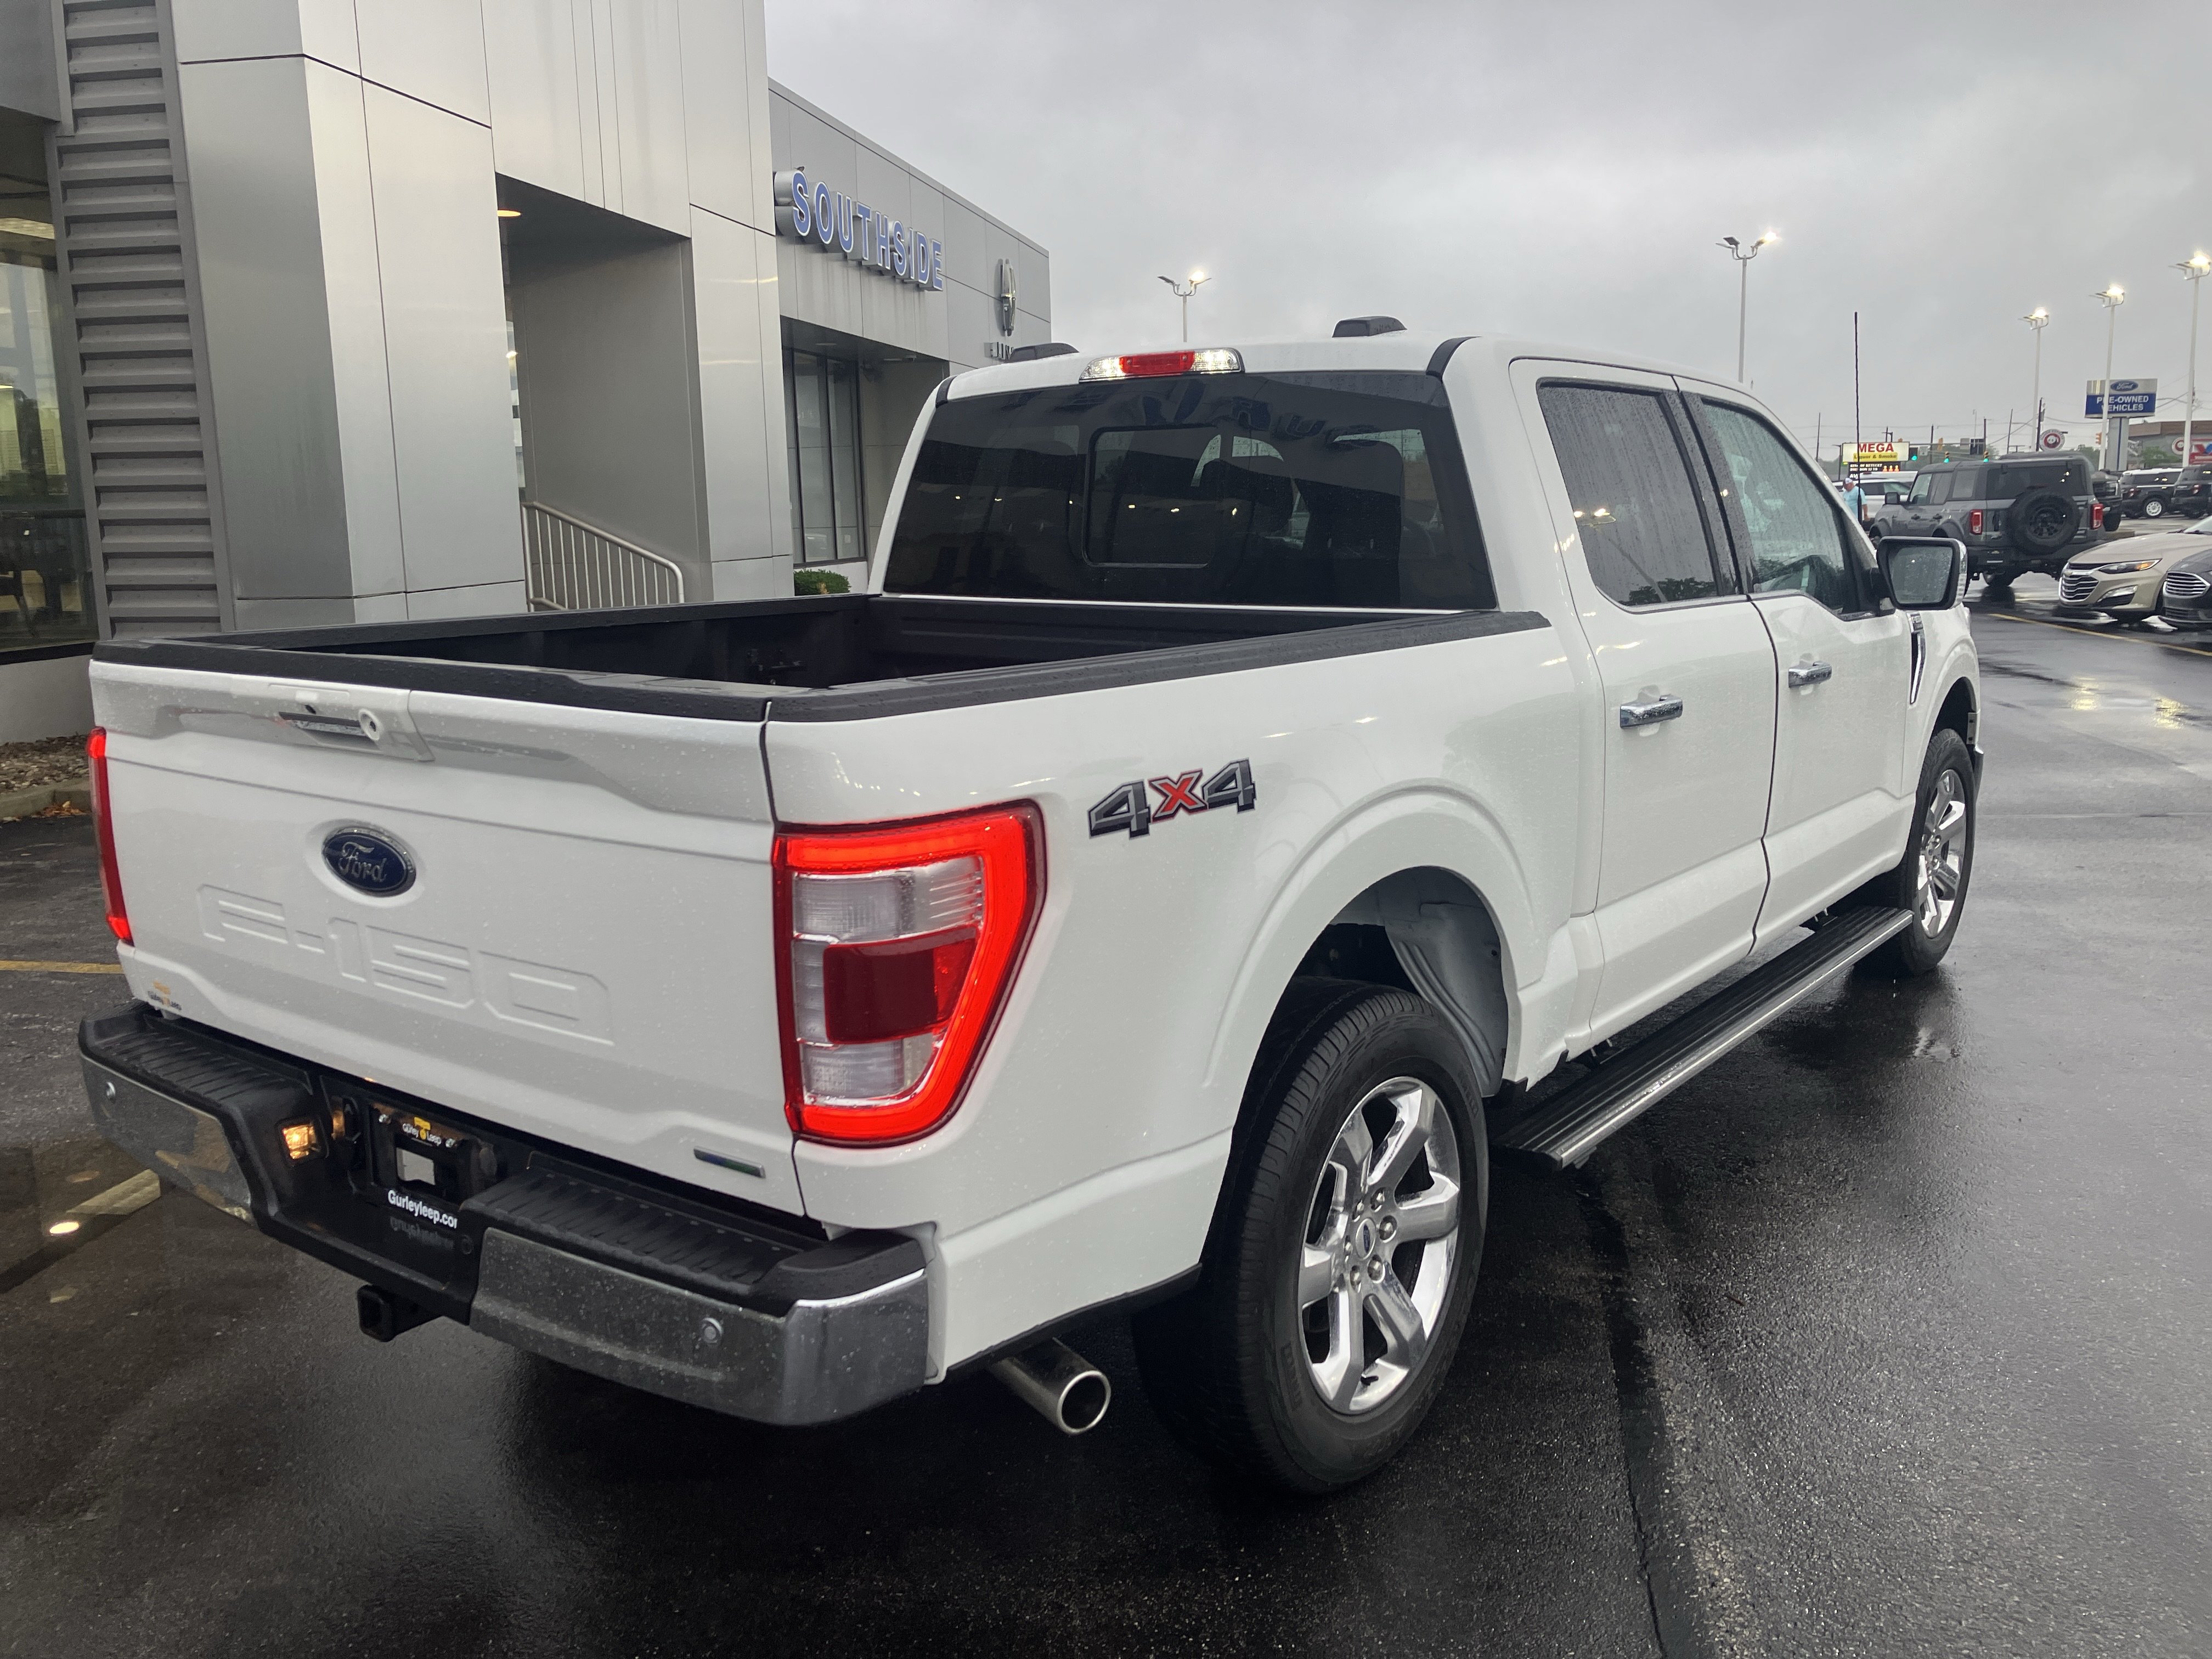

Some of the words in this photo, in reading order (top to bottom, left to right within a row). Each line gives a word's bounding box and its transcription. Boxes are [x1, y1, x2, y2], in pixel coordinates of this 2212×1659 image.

[792, 171, 944, 291] SOUTHSIDE
[2097, 396, 2149, 404] PE-OWNED
[1859, 442, 1894, 453] MEGA
[338, 841, 387, 883] Ford
[198, 883, 614, 1046] F-150
